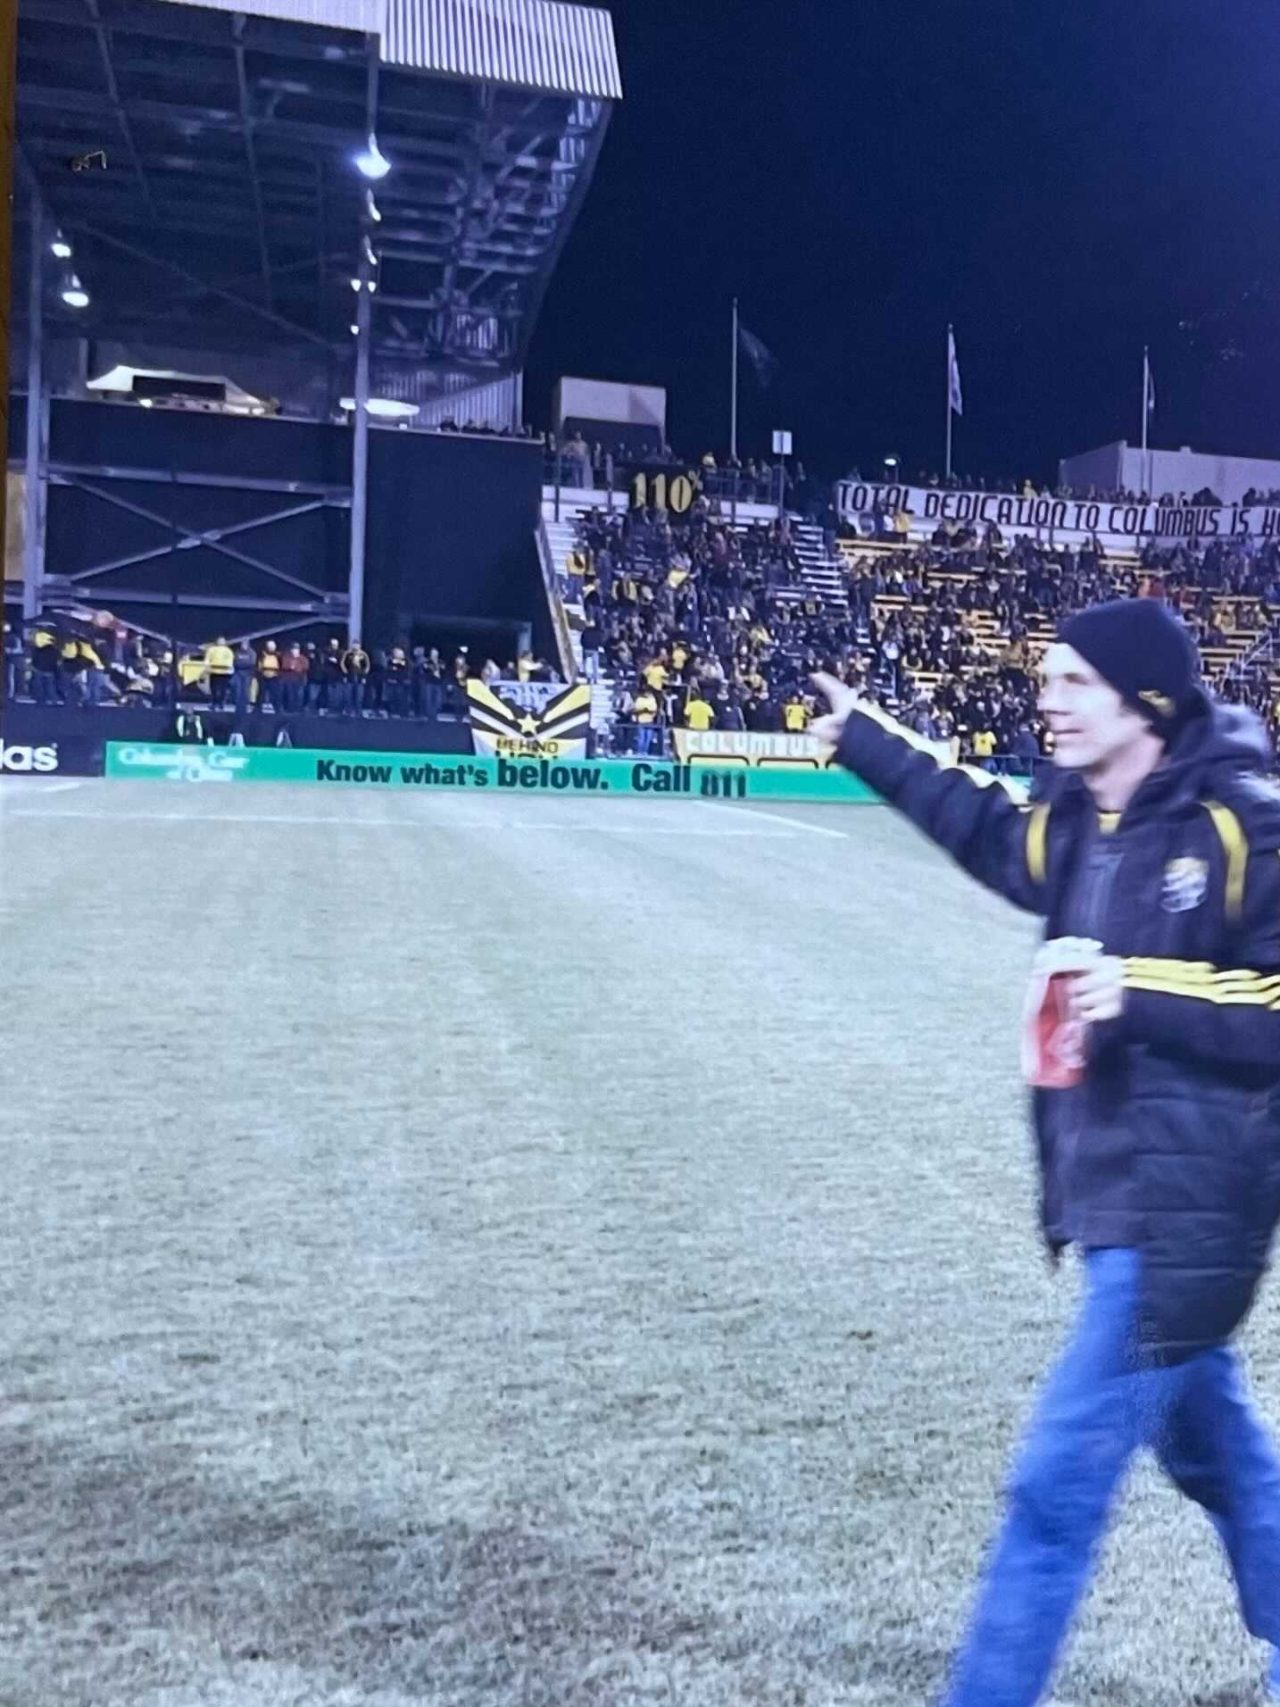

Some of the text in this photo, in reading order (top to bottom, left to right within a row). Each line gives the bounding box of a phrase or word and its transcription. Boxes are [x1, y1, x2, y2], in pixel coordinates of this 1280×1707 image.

[838, 482, 915, 514] TOTAL
[925, 492, 1068, 530] DEDICATION
[1075, 503, 1099, 532] TO
[1109, 505, 1221, 536] COLUMBUS
[1230, 505, 1249, 536] IS
[0, 738, 58, 771] as
[316, 759, 391, 783] Know
[400, 762, 488, 787] what's
[497, 758, 608, 790] below.
[631, 763, 690, 792] Call
